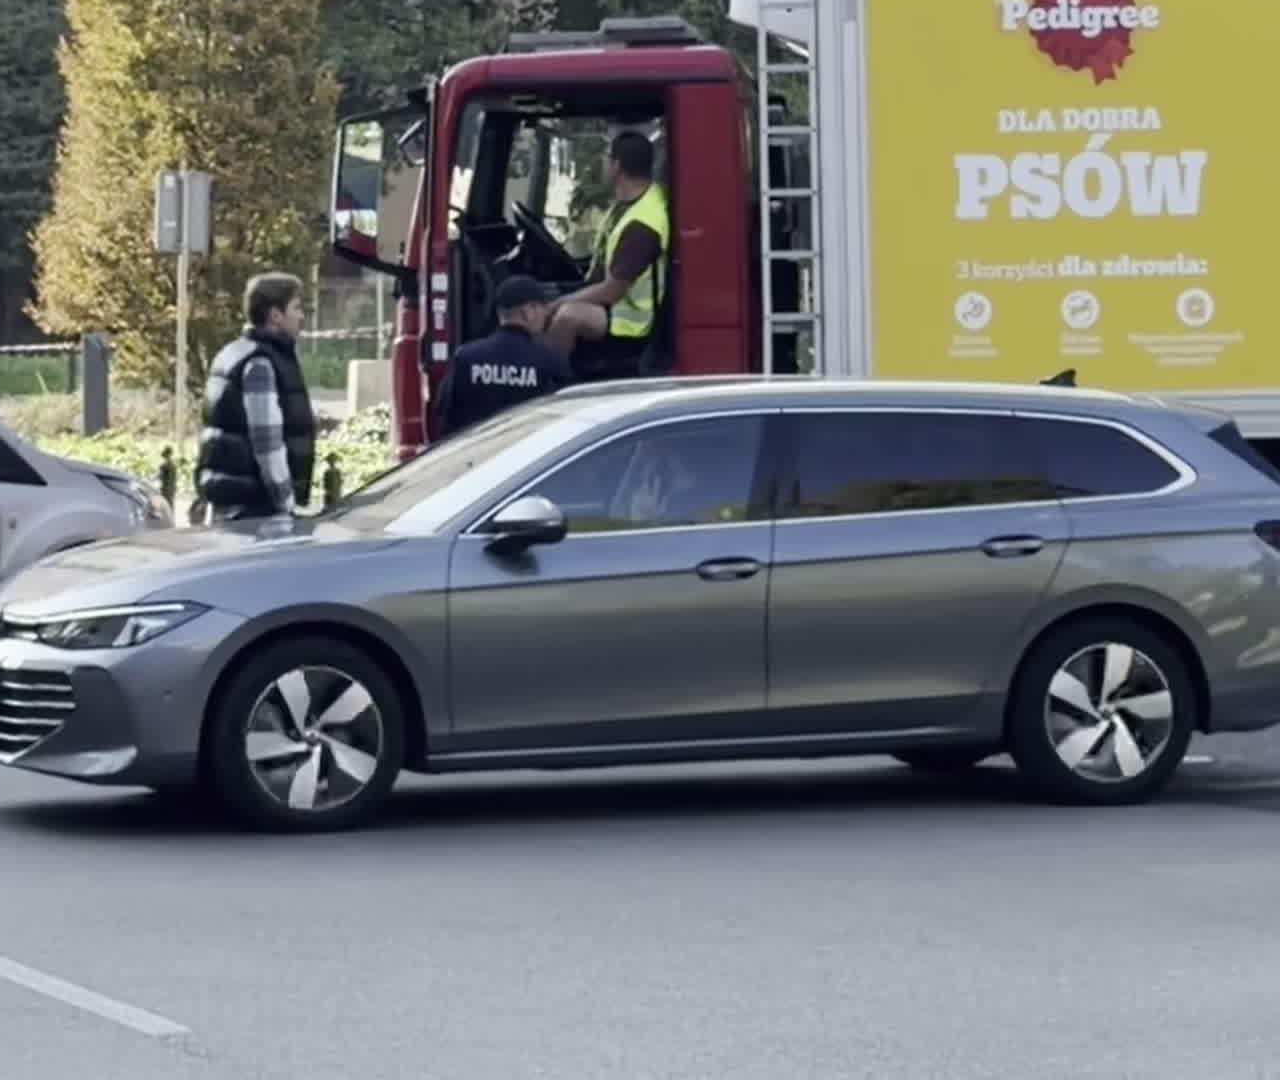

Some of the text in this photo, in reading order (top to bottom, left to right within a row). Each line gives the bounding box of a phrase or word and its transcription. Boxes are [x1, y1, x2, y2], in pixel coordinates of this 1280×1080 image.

[996, 106, 1162, 132] DLA DOBRA
[953, 132, 1209, 220] PSÓW
[1058, 254, 1097, 277] dla
[1101, 251, 1209, 277] zdrowia:
[471, 364, 538, 387] POLICJA
